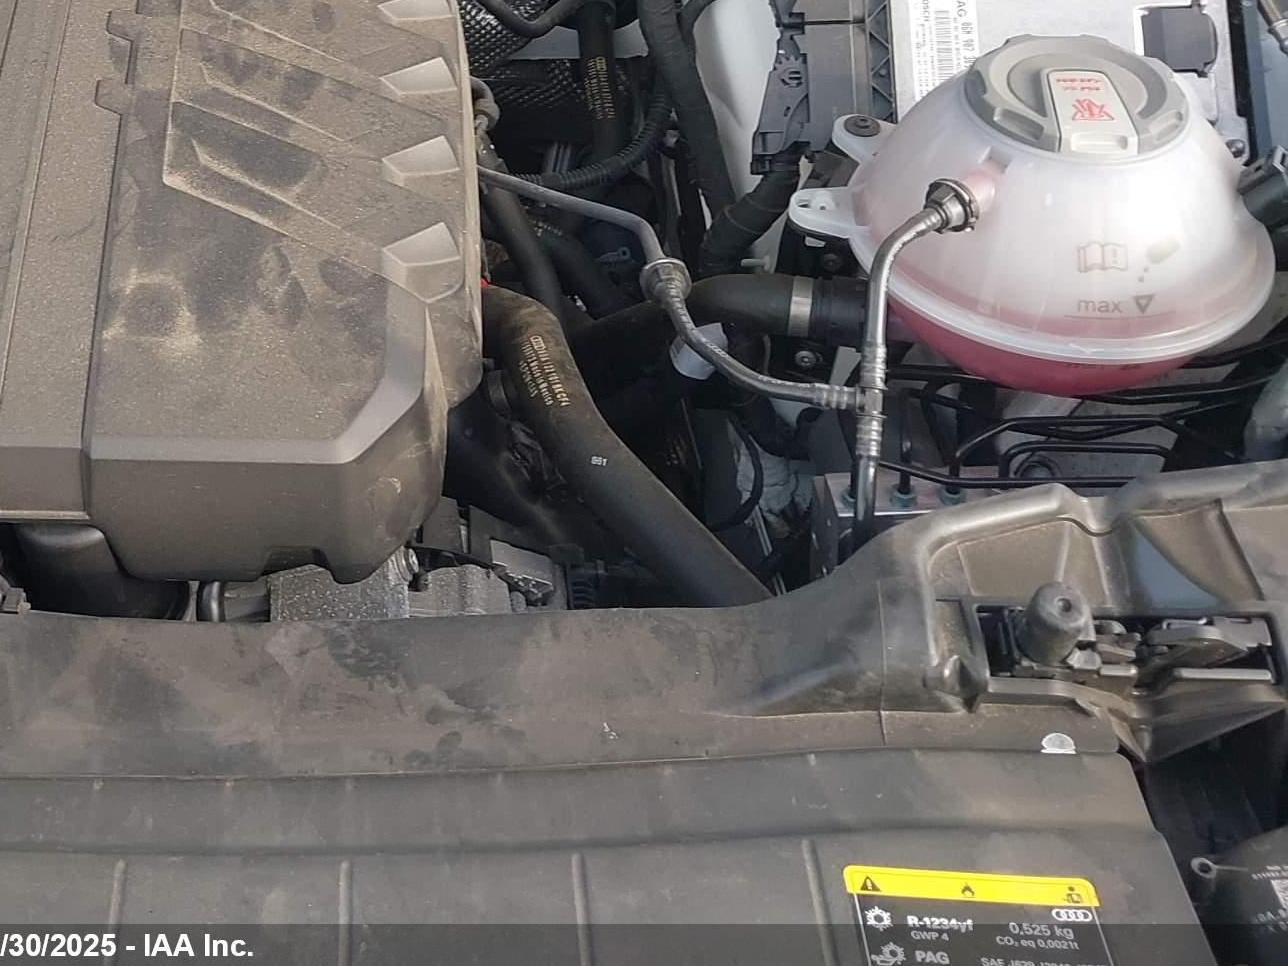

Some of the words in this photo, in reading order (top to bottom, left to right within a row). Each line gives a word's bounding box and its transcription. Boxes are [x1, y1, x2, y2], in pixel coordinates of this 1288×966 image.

[1078, 299, 1122, 313] max
[907, 915, 974, 932] R-1234yf
[911, 930, 940, 941] GWP
[942, 933, 950, 942] 4
[1054, 924, 1075, 940] kg
[1020, 939, 1037, 949] eq
[915, 950, 950, 965] PAG
[980, 957, 1005, 966] SAE
